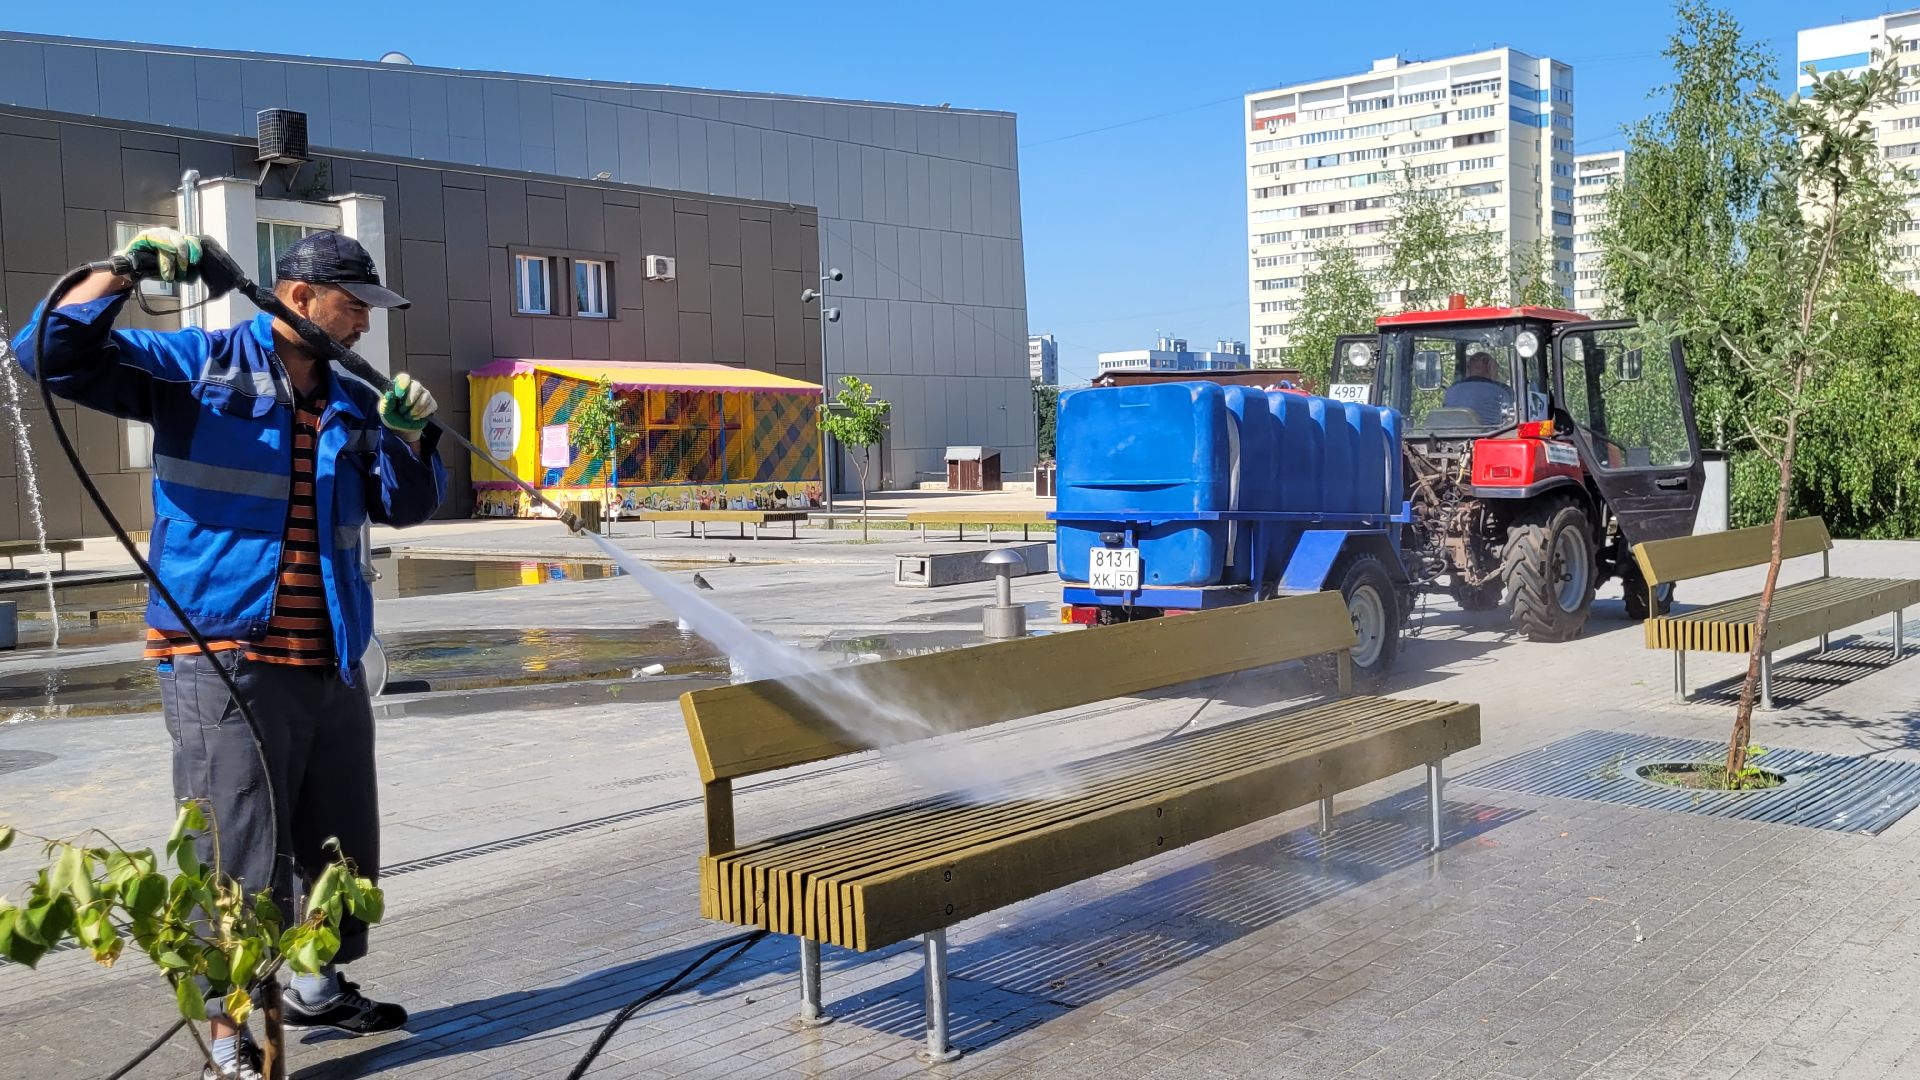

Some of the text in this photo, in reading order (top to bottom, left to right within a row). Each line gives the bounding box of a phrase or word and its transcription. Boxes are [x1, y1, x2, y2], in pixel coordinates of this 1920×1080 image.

[1334, 386, 1364, 399] 4987
[1096, 551, 1131, 568] 8131
[1093, 573, 1133, 587] ХК 50
